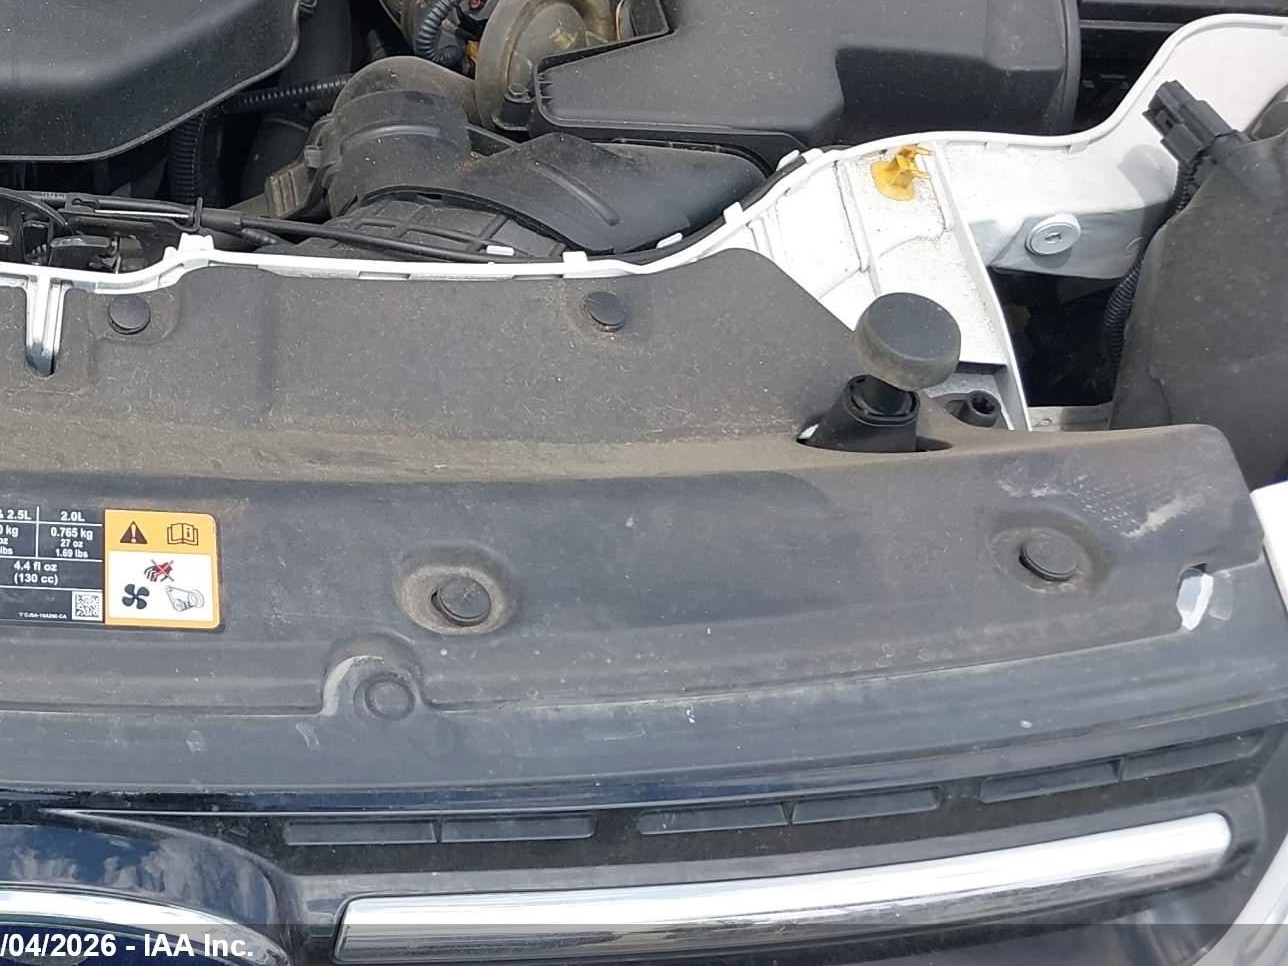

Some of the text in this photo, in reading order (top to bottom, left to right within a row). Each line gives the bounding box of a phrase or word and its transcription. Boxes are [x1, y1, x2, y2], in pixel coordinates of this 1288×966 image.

[7, 509, 32, 521] 2.5L
[60, 511, 85, 522] 2.0L
[5, 524, 19, 538] kg
[50, 526, 94, 541] 0.765 kg
[60, 539, 84, 548] 27 oz
[0, 546, 13, 555] lbs
[55, 548, 89, 558] 1.69 lbs
[13, 560, 58, 572] 4.4 fl oz
[14, 572, 59, 586] (130 cc)
